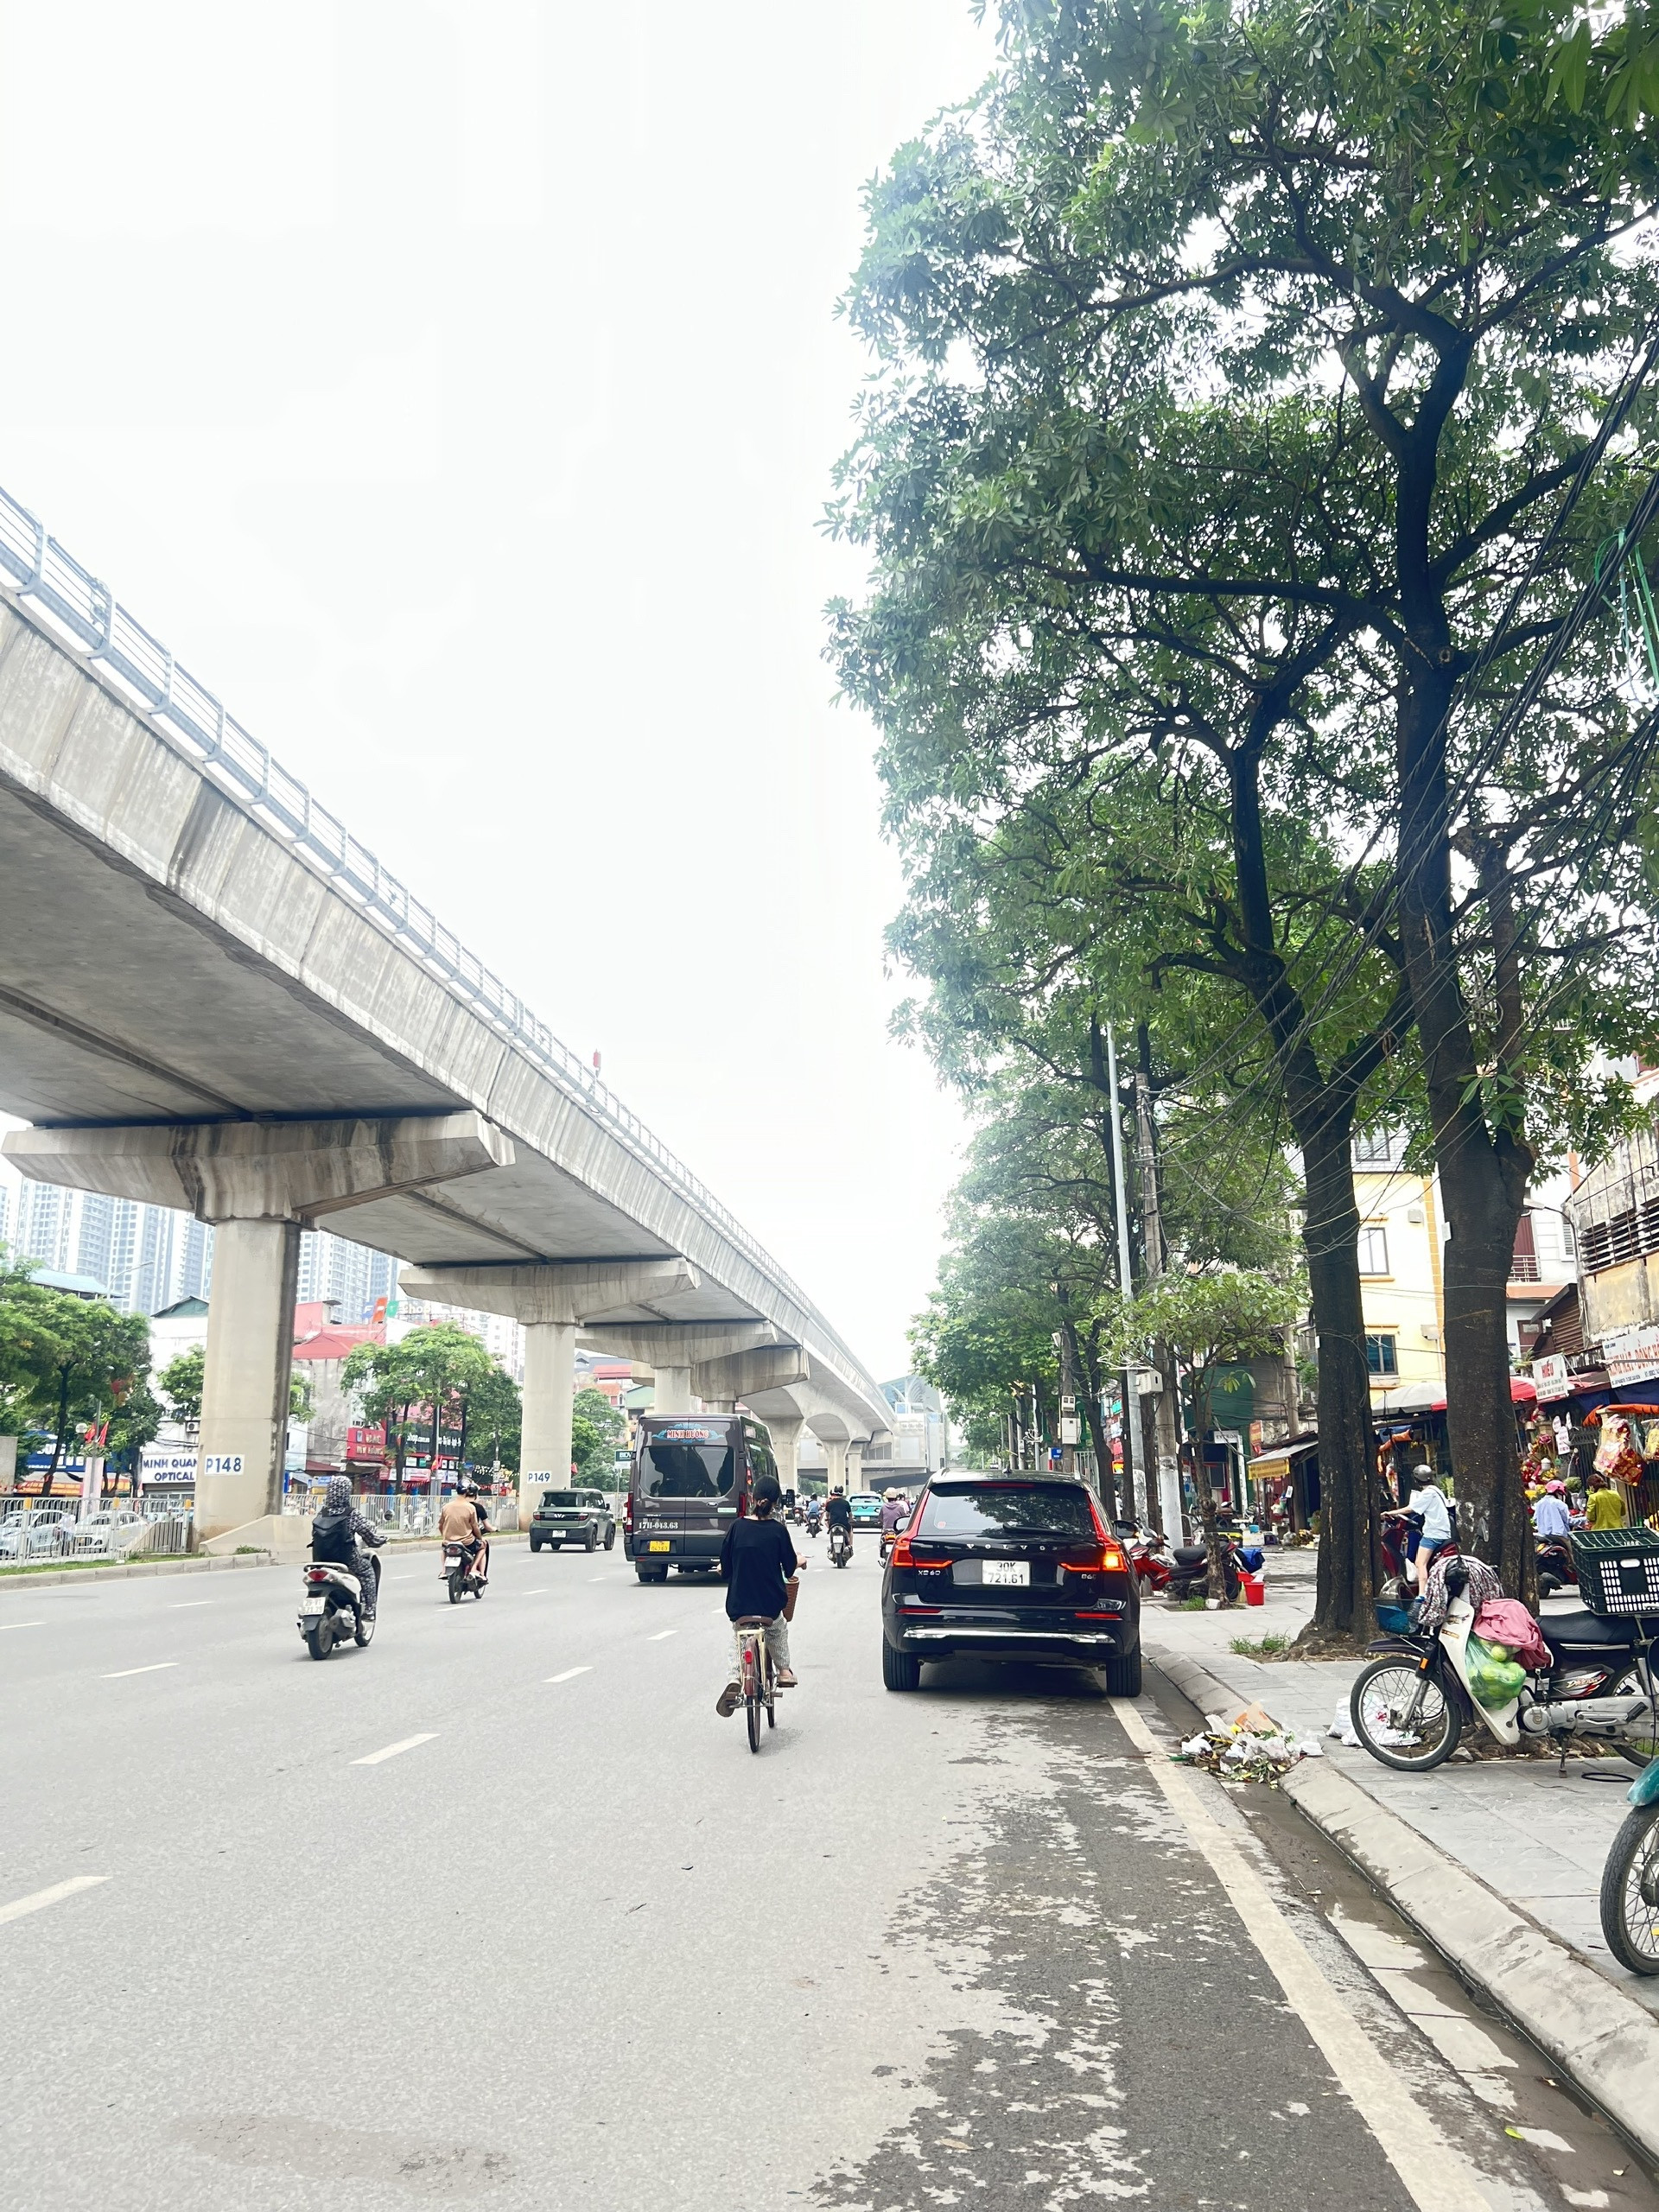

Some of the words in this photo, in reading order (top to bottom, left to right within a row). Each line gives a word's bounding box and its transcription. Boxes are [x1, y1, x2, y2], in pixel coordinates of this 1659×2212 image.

[667, 1429, 685, 1439] MINH
[143, 1459, 168, 1468] MINH
[206, 1457, 242, 1473] P148
[155, 1471, 194, 1481] OPTICAL
[528, 1472, 550, 1482] P149
[996, 1561, 1016, 1573] 30K
[988, 1573, 1024, 1585] 721.61
